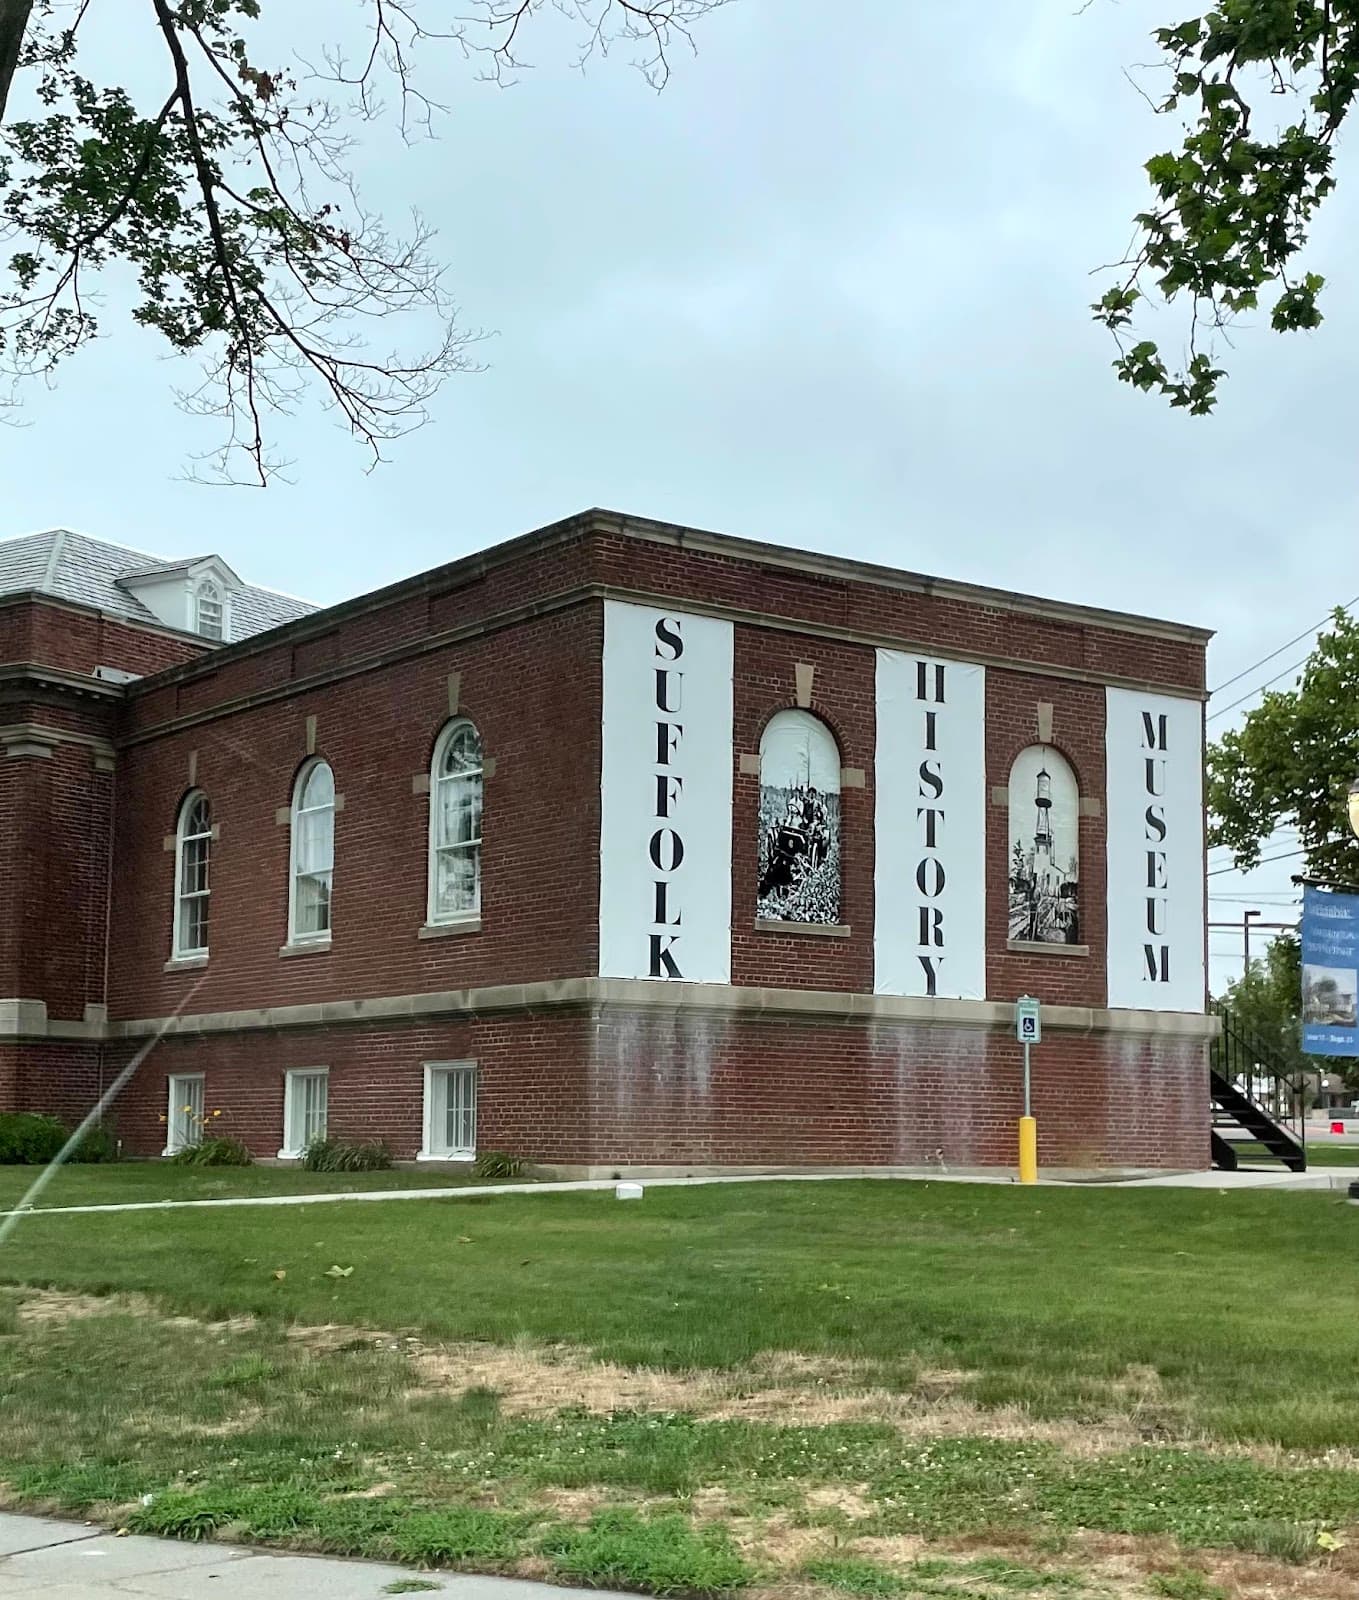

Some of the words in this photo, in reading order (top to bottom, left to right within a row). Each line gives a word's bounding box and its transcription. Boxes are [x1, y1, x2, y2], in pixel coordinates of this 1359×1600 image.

[649, 617, 685, 979] SUFFOLK
[916, 661, 946, 996] HISTORY
[1140, 711, 1169, 983] MUSEUM
